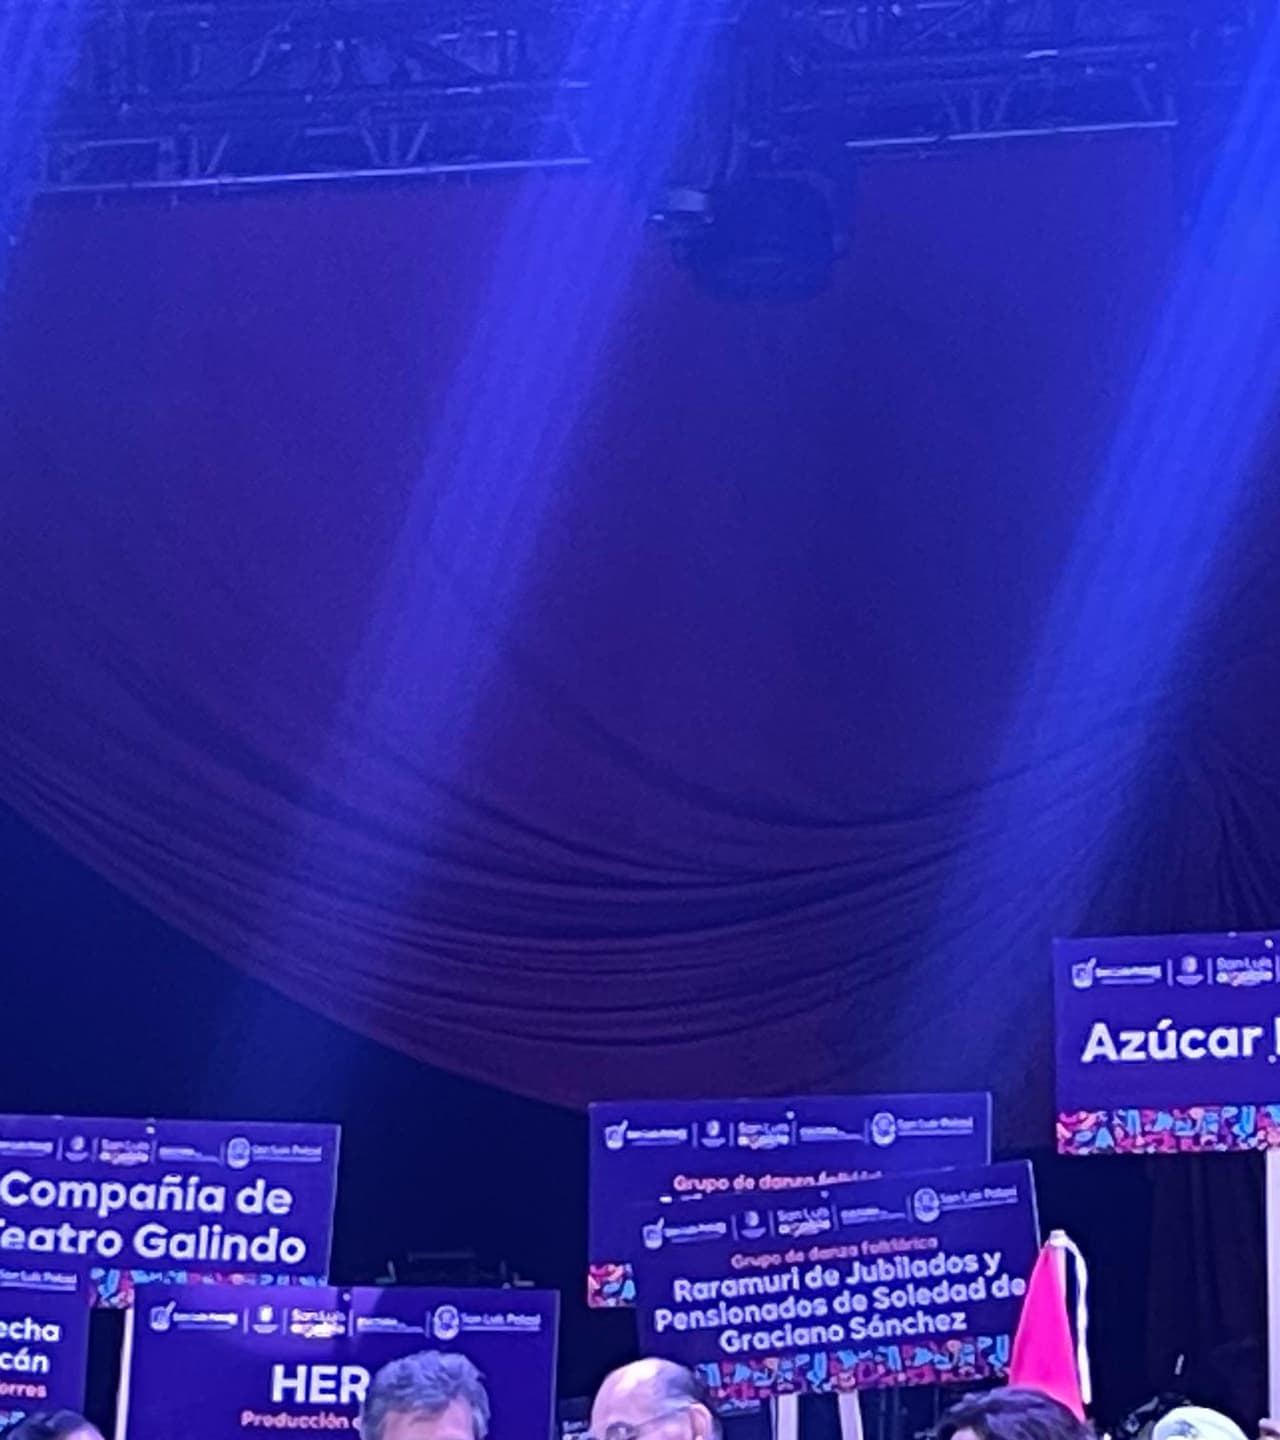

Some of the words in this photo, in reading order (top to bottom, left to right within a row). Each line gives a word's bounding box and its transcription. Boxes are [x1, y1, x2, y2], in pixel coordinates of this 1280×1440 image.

[1081, 1018, 1264, 1063] Azúcar
[235, 1178, 293, 1215] de
[673, 1174, 729, 1193] Grupo
[733, 1174, 755, 1190] de
[133, 1222, 307, 1264] Galindo
[730, 1253, 782, 1269] Grupo
[673, 1266, 800, 1303] Raramuri
[804, 1262, 840, 1289] de
[845, 1251, 979, 1285] Jubilados
[983, 1251, 1002, 1276] y
[654, 1292, 828, 1333] Pensionados
[832, 1288, 868, 1315] de
[872, 1278, 987, 1312] Soledad
[990, 1274, 1027, 1299] de
[718, 1321, 846, 1354] Graciano
[849, 1309, 968, 1341] Sánchez
[272, 1364, 370, 1404] HER
[240, 1409, 350, 1430] Producción
